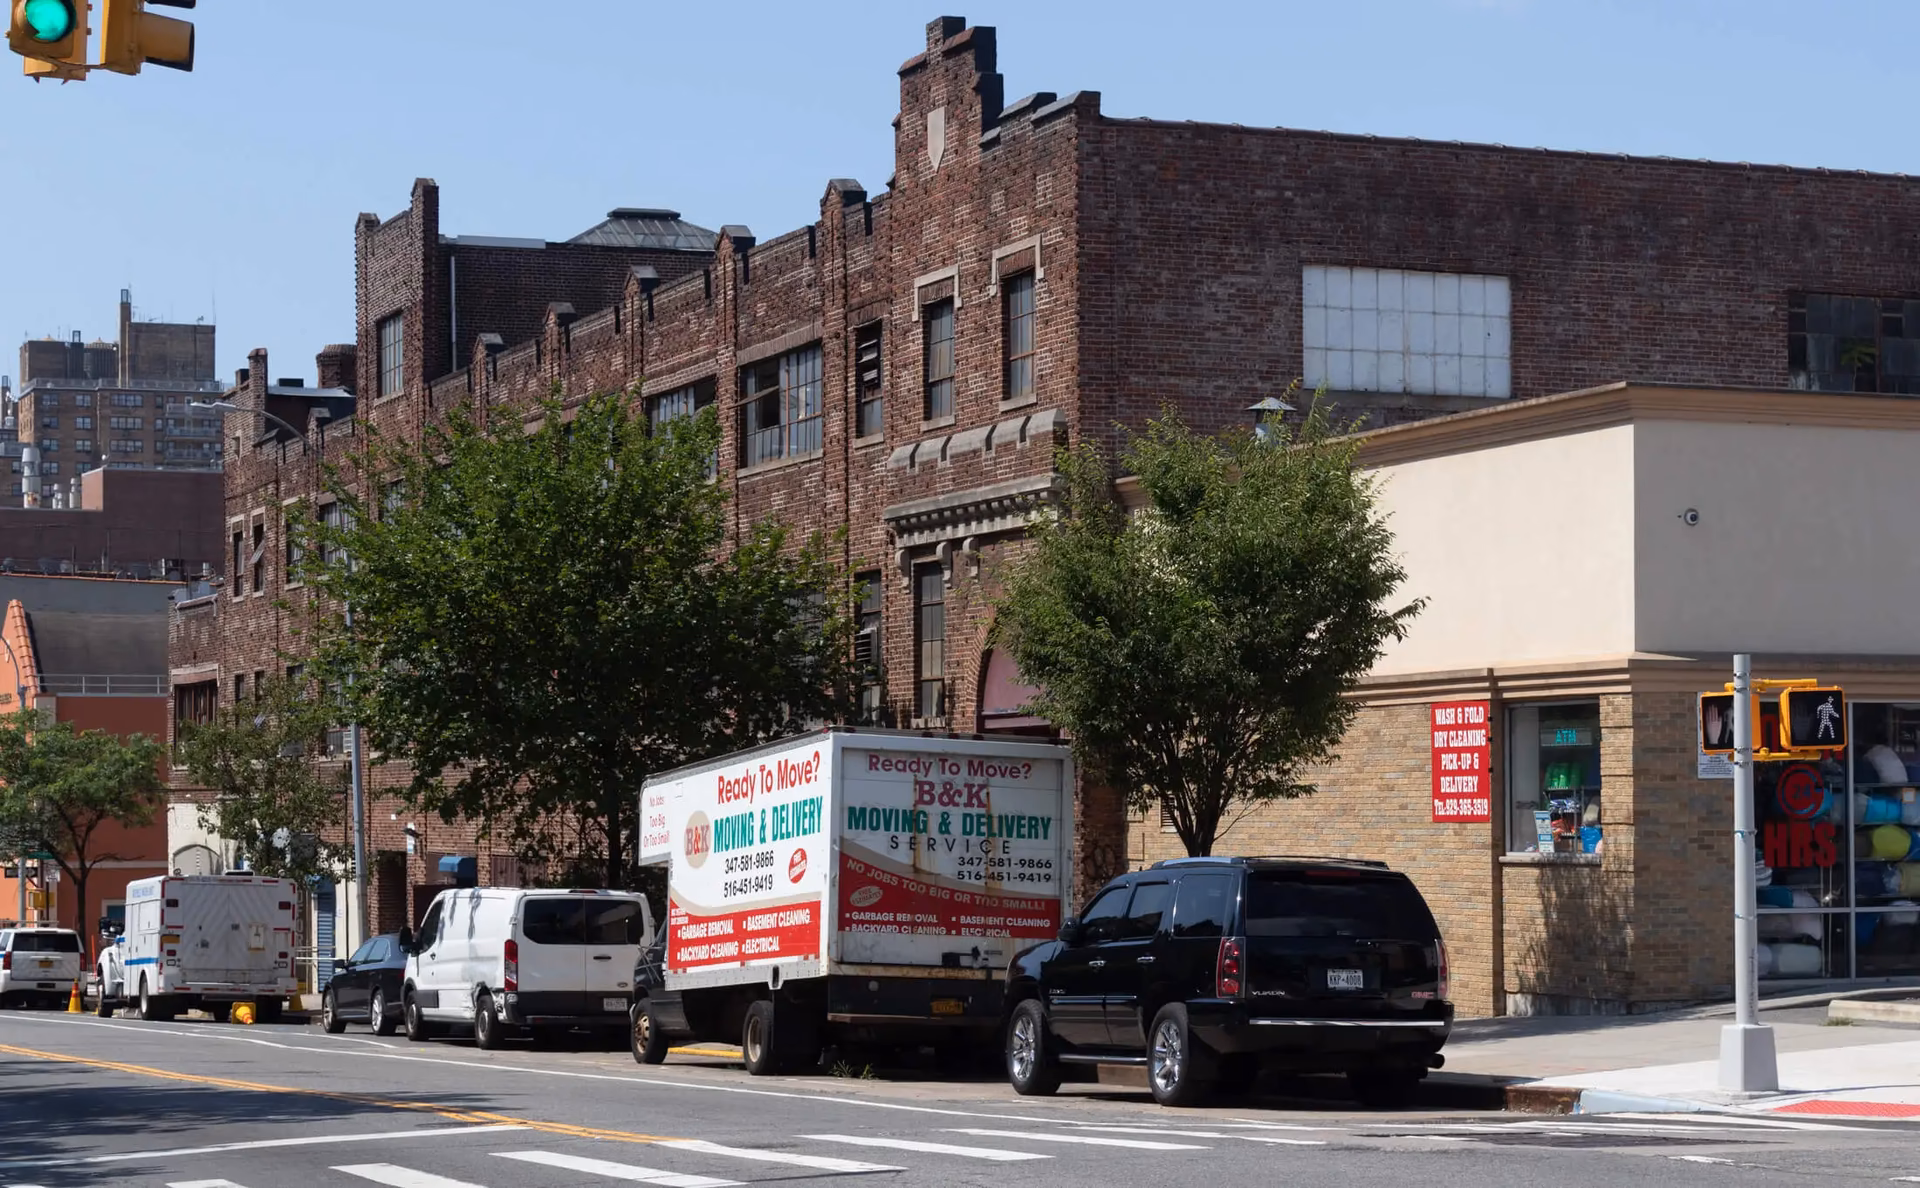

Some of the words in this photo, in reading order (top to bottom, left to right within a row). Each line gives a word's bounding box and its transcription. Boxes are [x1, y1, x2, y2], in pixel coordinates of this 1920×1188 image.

[1435, 708, 1455, 725] WASH
[1457, 708, 1463, 725] &
[1464, 706, 1484, 724] FOLD
[1434, 731, 1448, 748] DRY
[1449, 729, 1486, 747] CLEANING
[1555, 729, 1577, 745] ATM
[868, 754, 933, 778] Ready
[938, 758, 961, 776] To
[967, 759, 1032, 779] Move?
[1441, 753, 1472, 770] PICK-UP
[1473, 752, 1479, 769] &
[718, 769, 757, 804] Ready
[759, 764, 773, 794] To
[777, 751, 821, 790] Move?
[1440, 776, 1479, 793] DELIVERY
[915, 780, 988, 809] B&K
[650, 816, 658, 828] Too
[658, 813, 666, 828] Big
[713, 811, 754, 853] MOVING
[759, 808, 767, 844] &
[772, 796, 823, 842] DELIVERY
[848, 806, 928, 834] MOVING
[938, 811, 952, 835] &
[962, 812, 1052, 840] DELIVERY
[685, 824, 710, 856] B&K
[890, 835, 1011, 854] SERVICE
[1764, 822, 1836, 868] HRS
[725, 850, 774, 874] 347-581-9866
[957, 856, 1053, 869] 347-581-9866
[723, 874, 773, 898] 516-451-9419
[847, 860, 865, 874] NO
[867, 868, 898, 886] JOBS
[902, 880, 926, 893] TOO
[929, 887, 950, 899] BIG
[954, 892, 971, 904] OR
[974, 896, 999, 907] TOO
[1003, 899, 1045, 911] SMALL!
[957, 871, 1052, 883] 516-451-9419
[747, 913, 777, 931] BASEMENT
[778, 908, 811, 926] CLEANING
[852, 912, 894, 921] GARBAGE
[1006, 918, 1051, 927] CLEANING
[681, 924, 707, 940] GARBAGE
[708, 919, 734, 937] REMOVAL
[851, 924, 899, 933] BACKYARD
[681, 944, 709, 962] BACKYARD
[710, 941, 739, 958] CLEANING
[745, 936, 780, 954] ELECTRICAL
[1411, 991, 1434, 999] GMC
